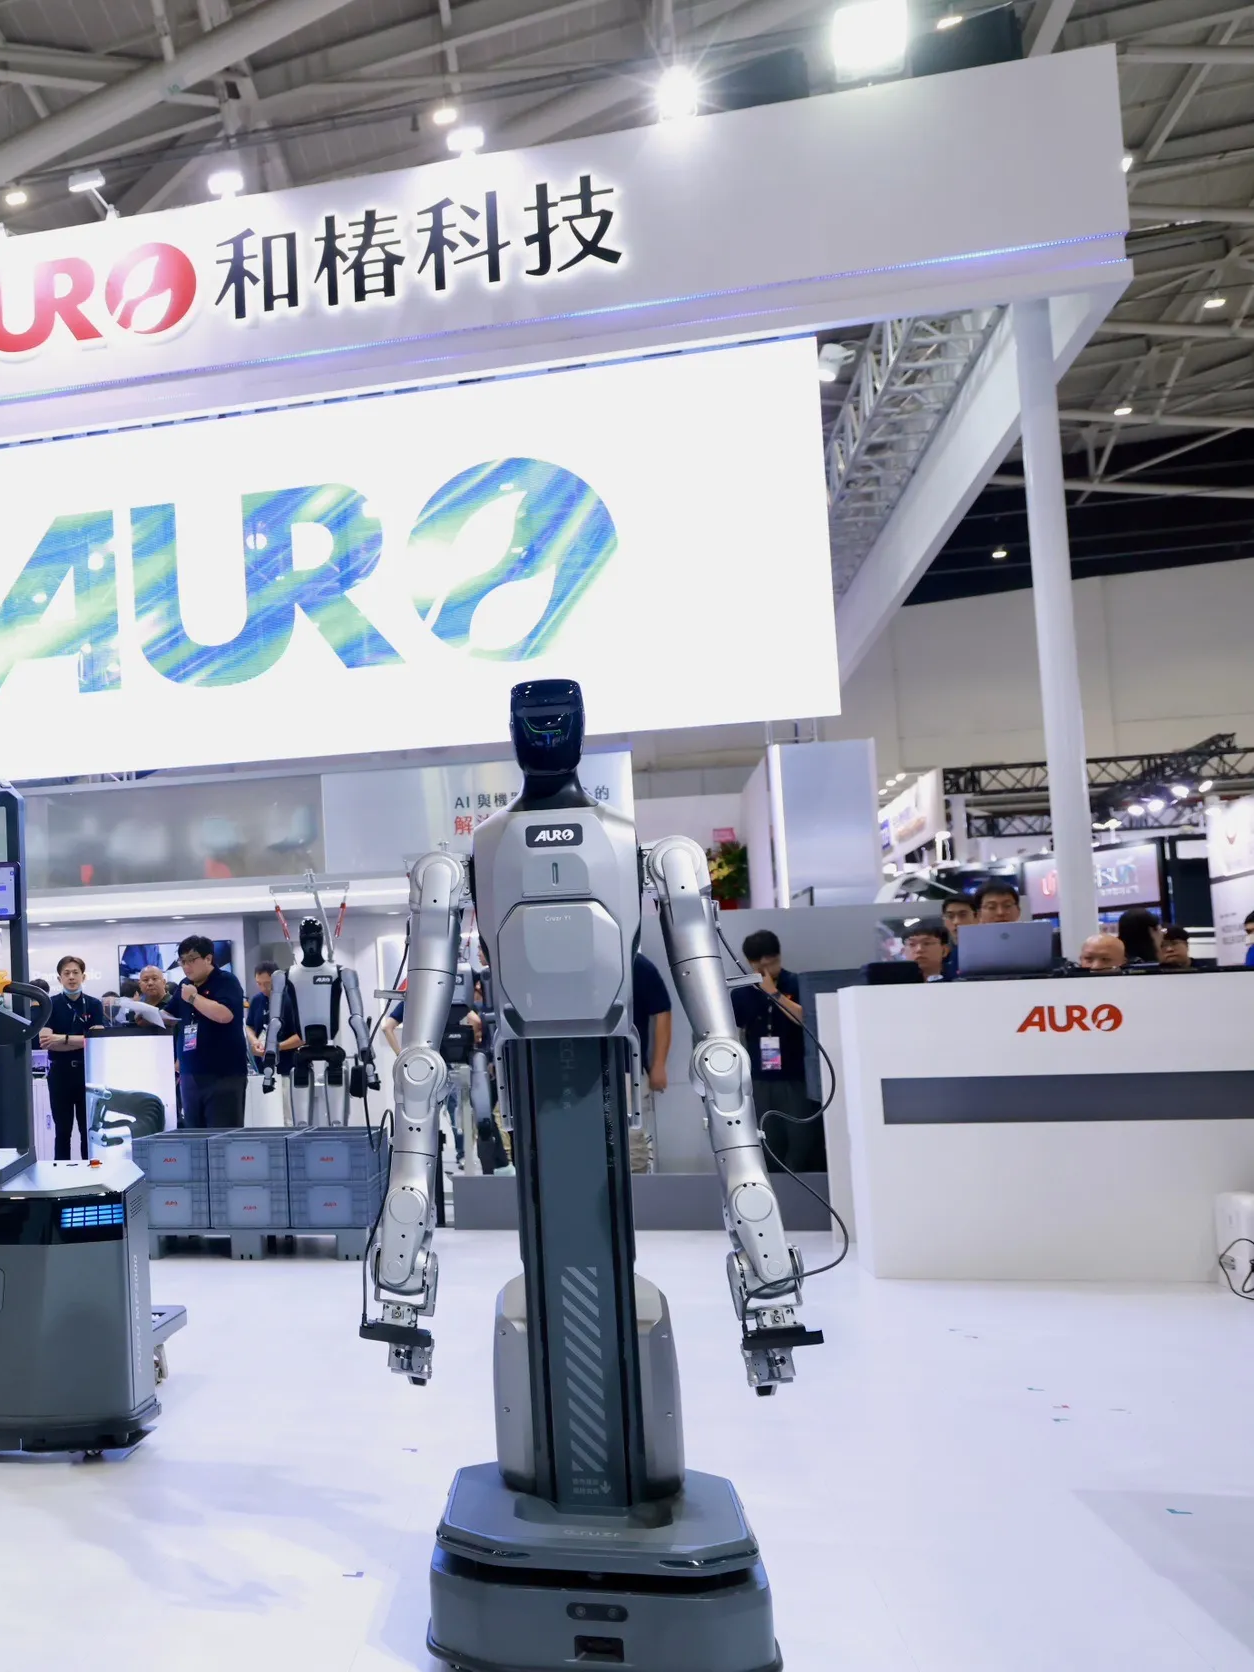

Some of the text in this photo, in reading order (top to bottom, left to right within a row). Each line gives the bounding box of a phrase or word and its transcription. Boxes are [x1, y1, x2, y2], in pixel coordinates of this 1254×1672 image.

[213, 173, 624, 320] 和椿科技
[454, 796, 470, 809] AI
[534, 828, 575, 842] AURO
[1016, 1003, 1123, 1032] AURO
